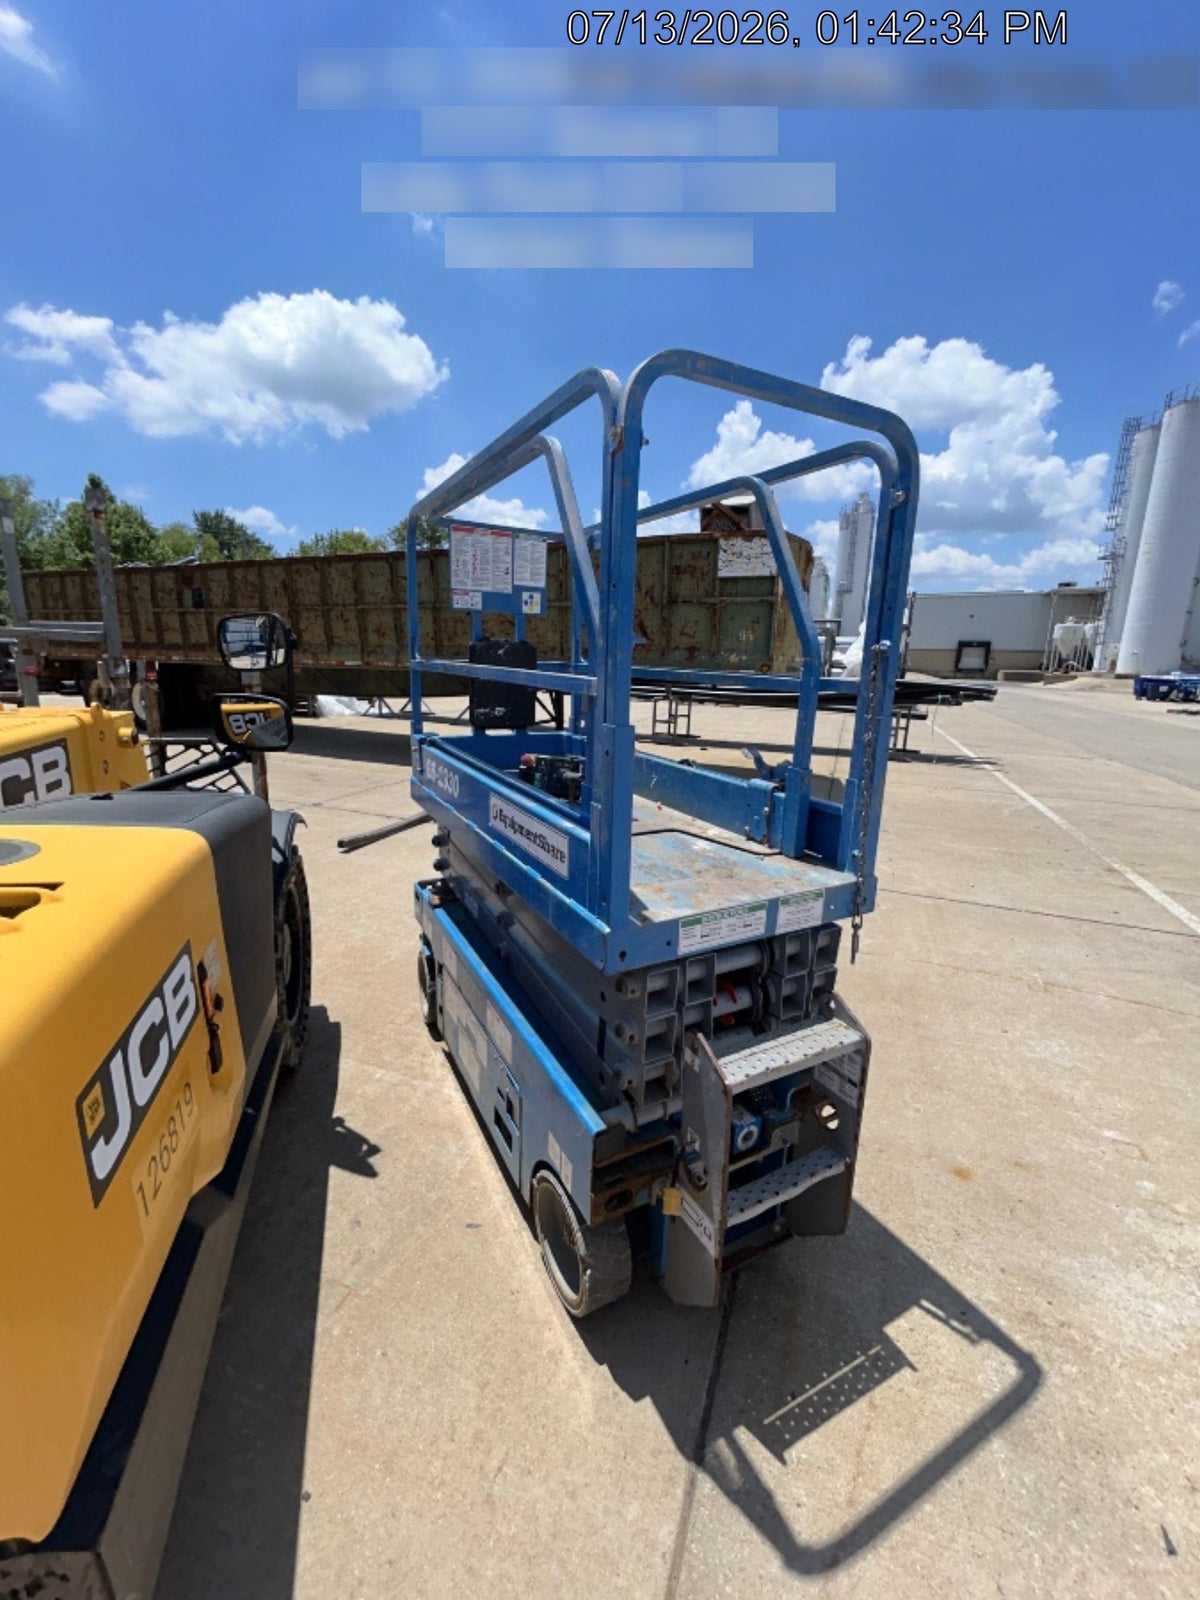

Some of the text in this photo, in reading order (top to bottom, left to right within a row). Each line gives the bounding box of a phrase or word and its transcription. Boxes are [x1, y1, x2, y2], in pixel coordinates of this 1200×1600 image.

[499, 807, 567, 863] EquipmentShare
[91, 954, 197, 1180] JCB
[136, 1081, 194, 1217] 126819
